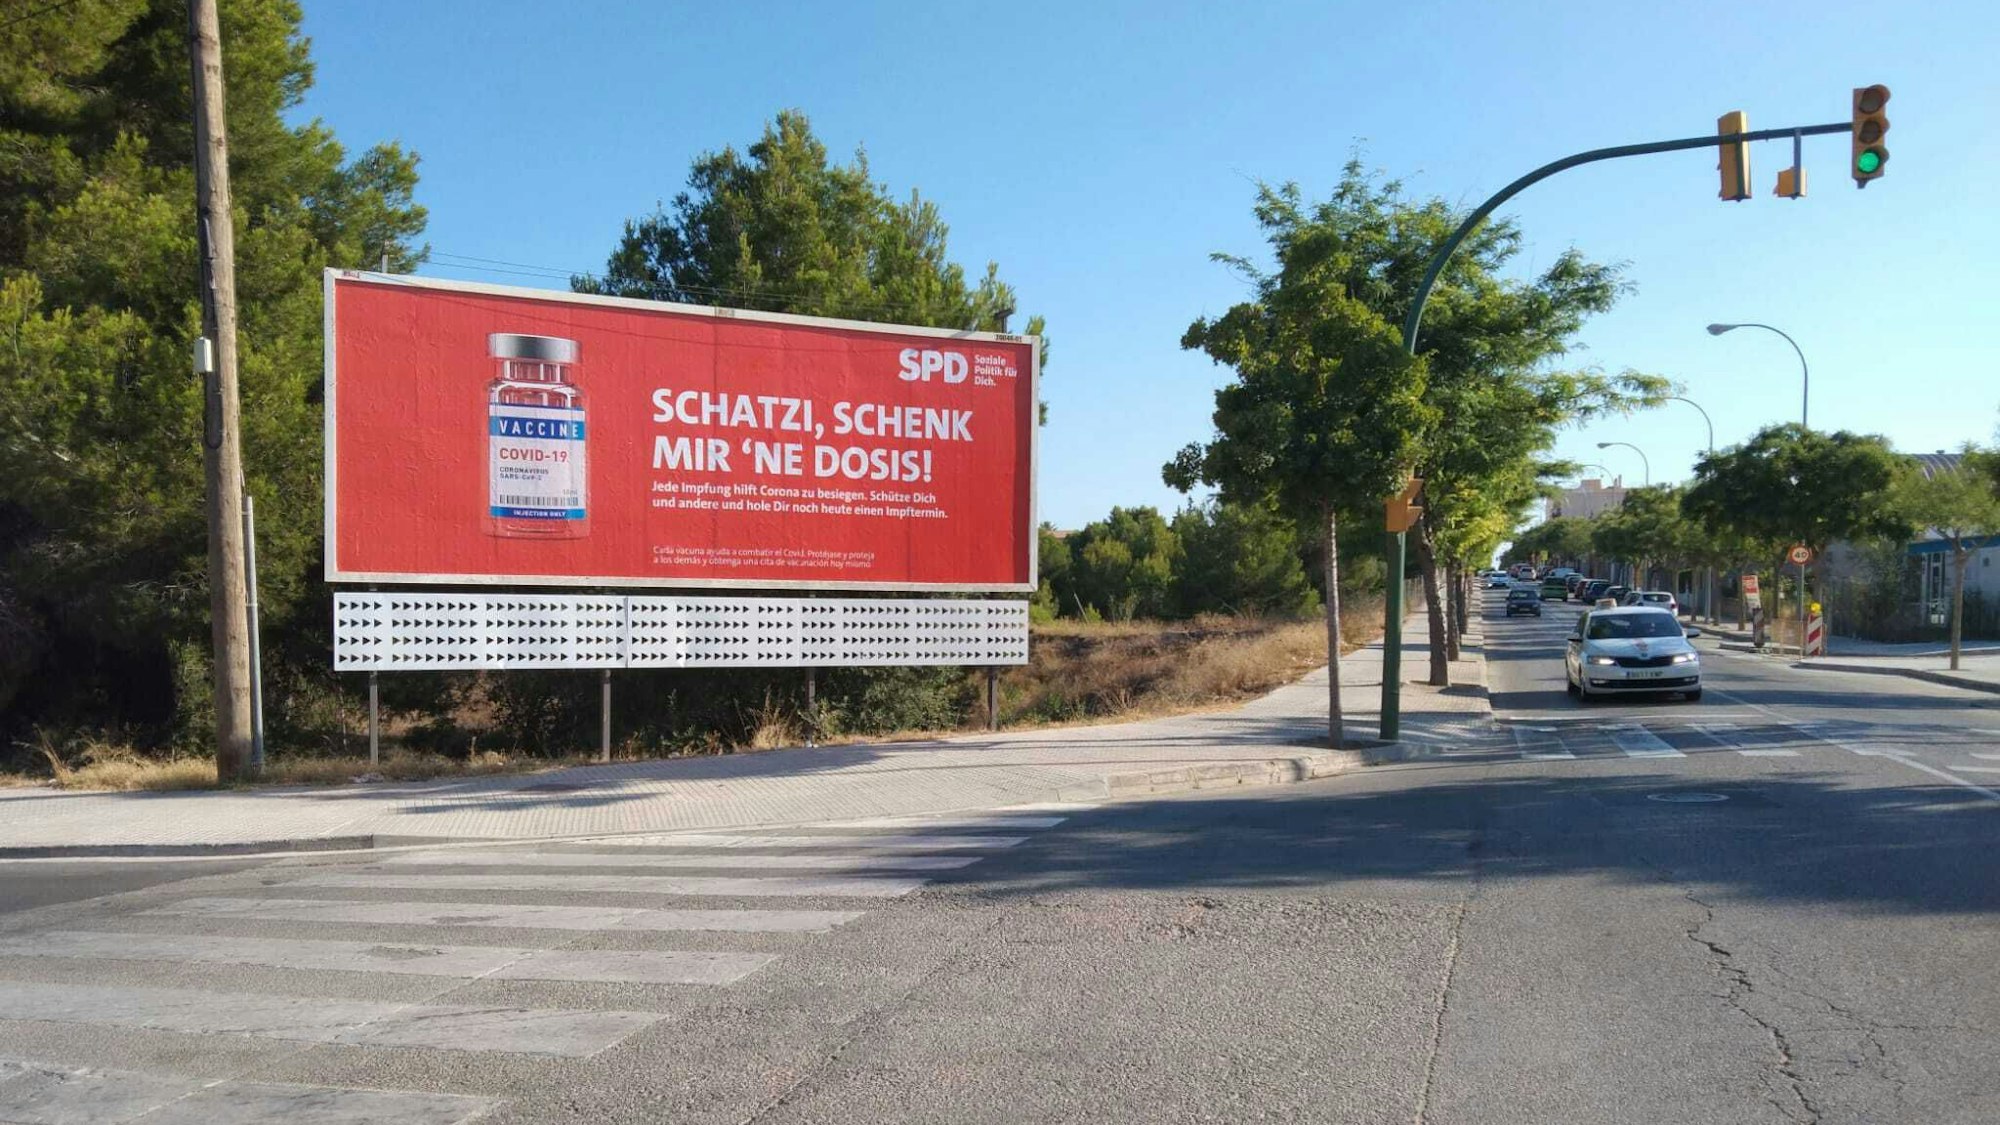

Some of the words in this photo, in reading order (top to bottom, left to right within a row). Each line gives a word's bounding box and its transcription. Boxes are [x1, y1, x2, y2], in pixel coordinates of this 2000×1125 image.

[898, 347, 969, 384] SPD
[974, 354, 1006, 366] Soziale
[974, 365, 1003, 376] Politik
[1004, 368, 1017, 378] für
[974, 375, 997, 387] Dich.
[652, 388, 824, 440] SCHATZI,
[833, 400, 973, 442] SCHENK
[500, 420, 579, 437] VACCINE
[500, 448, 568, 462] COVID-19
[652, 435, 732, 472] MIR
[814, 445, 932, 483] DOSIS!
[652, 481, 679, 493] Jede
[682, 482, 732, 498] Impfung
[733, 484, 757, 496] hilft
[760, 485, 800, 498] Corona
[801, 489, 815, 498] zu
[817, 488, 868, 502] besiegen.
[870, 490, 911, 503] Schütze
[913, 492, 936, 504] Dich
[652, 498, 676, 508] und
[678, 498, 719, 510] andere
[722, 500, 744, 511] und
[747, 501, 771, 512] hole
[773, 501, 790, 513] Dir
[792, 502, 818, 513] noch
[821, 502, 852, 515] heute
[854, 505, 884, 516] einen
[886, 506, 948, 520] Impftermin.
[675, 548, 705, 556] vacuna
[1795, 551, 1808, 559] 40
